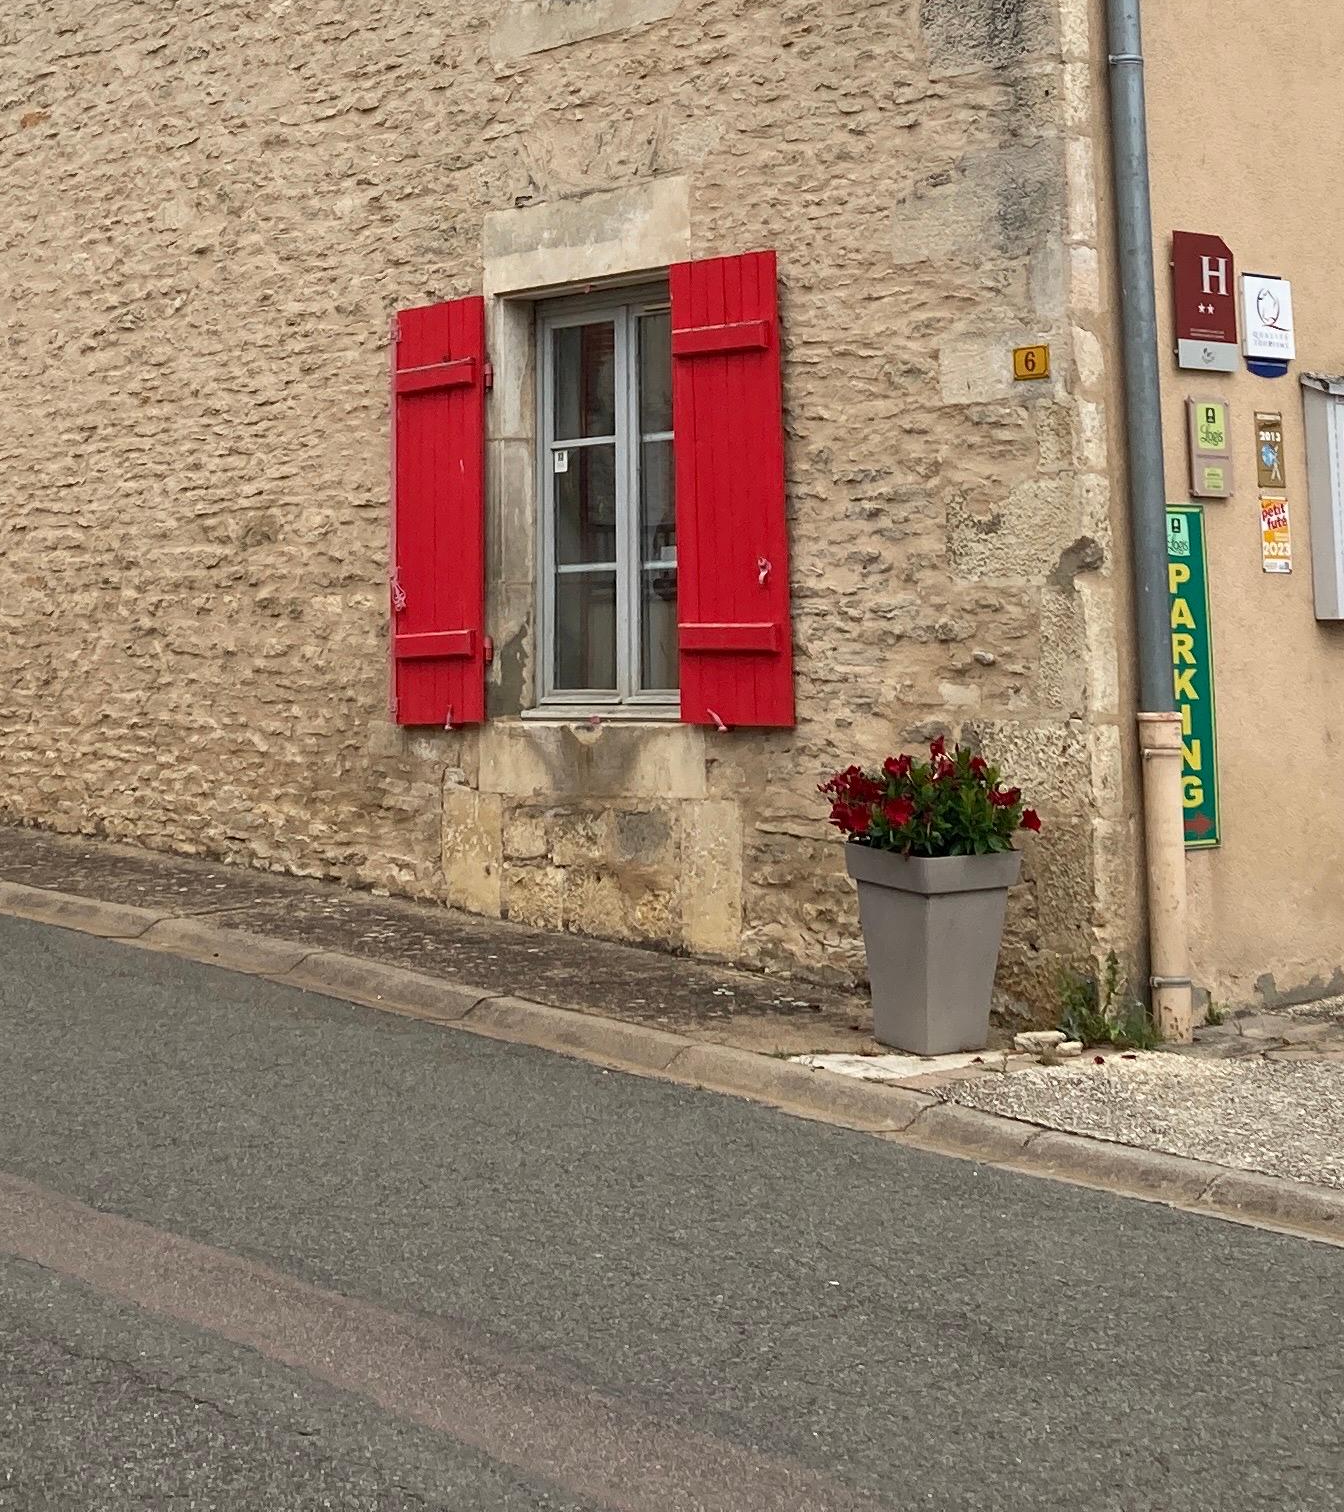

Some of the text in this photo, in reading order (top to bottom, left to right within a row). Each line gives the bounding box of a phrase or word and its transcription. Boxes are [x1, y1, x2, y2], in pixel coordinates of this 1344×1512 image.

[1200, 255, 1229, 296] H
[1024, 351, 1036, 372] 6
[1166, 562, 1205, 808] PARKING
